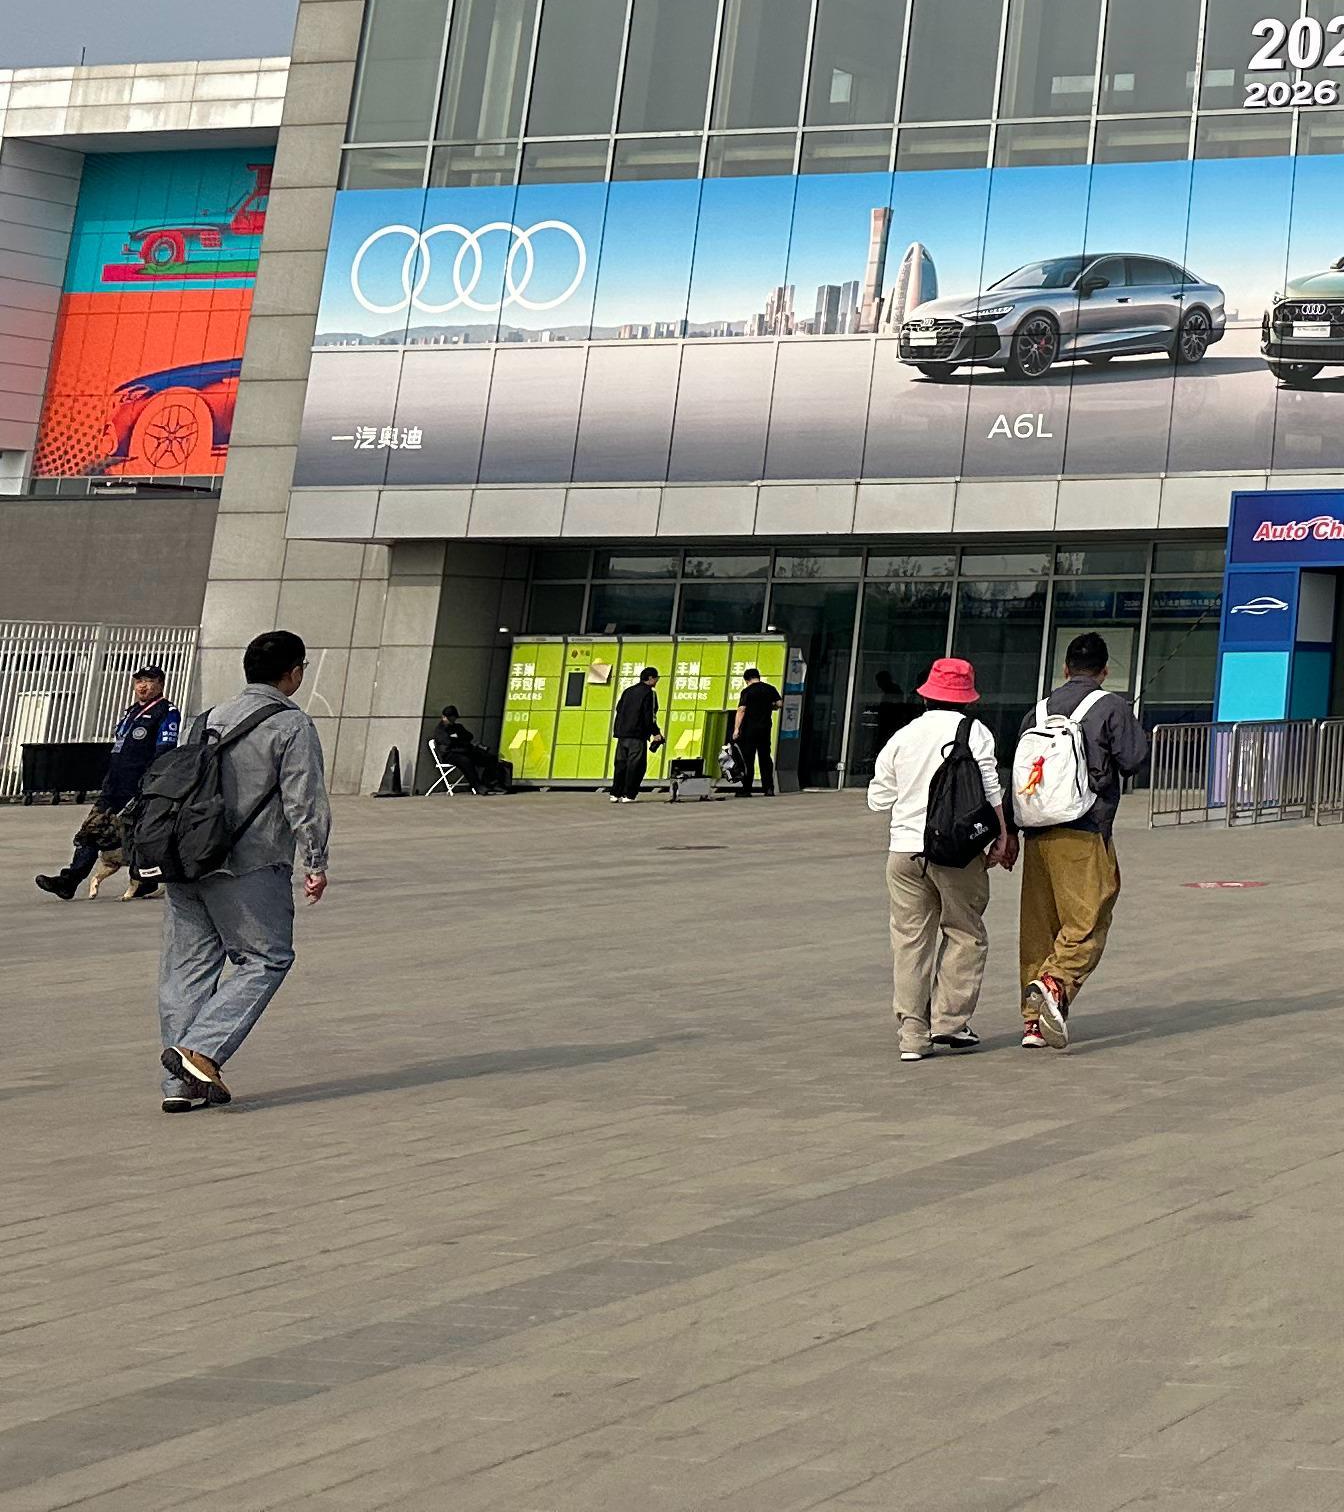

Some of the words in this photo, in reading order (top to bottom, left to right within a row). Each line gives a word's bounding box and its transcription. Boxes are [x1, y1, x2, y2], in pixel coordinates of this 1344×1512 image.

[1243, 80, 1336, 108] 2026
[331, 425, 423, 449] 一汽奥迪
[987, 413, 1053, 440] A6L
[1253, 521, 1309, 541] Auto
